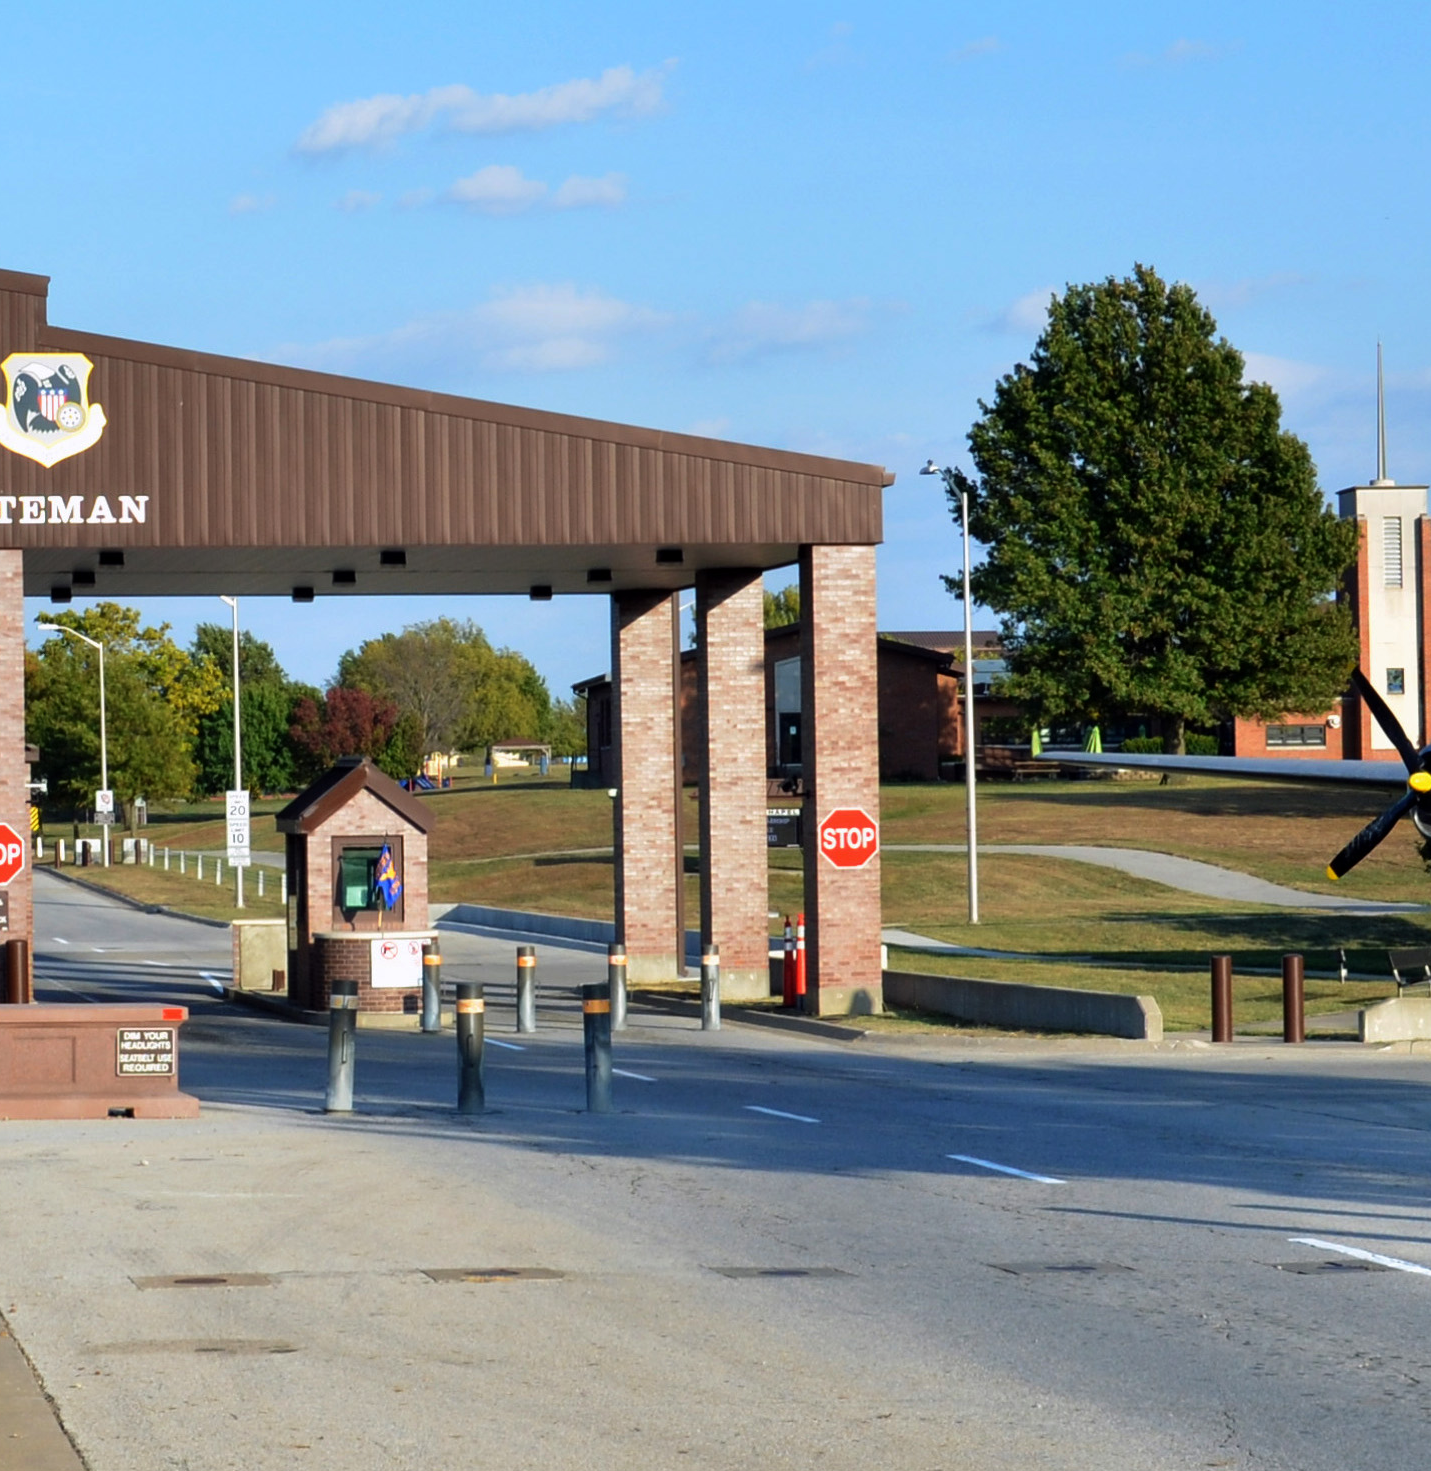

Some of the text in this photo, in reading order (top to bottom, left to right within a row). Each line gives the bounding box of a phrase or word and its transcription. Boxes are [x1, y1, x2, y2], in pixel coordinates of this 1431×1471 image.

[230, 805, 246, 816] 20
[232, 833, 245, 844] 10
[823, 827, 875, 850] STOP
[123, 1031, 169, 1040] DIM YOUR
[121, 1041, 171, 1050] HEADLIGHTS
[120, 1053, 173, 1062] SEATBELT USE
[122, 1063, 169, 1072] REQUIRED
